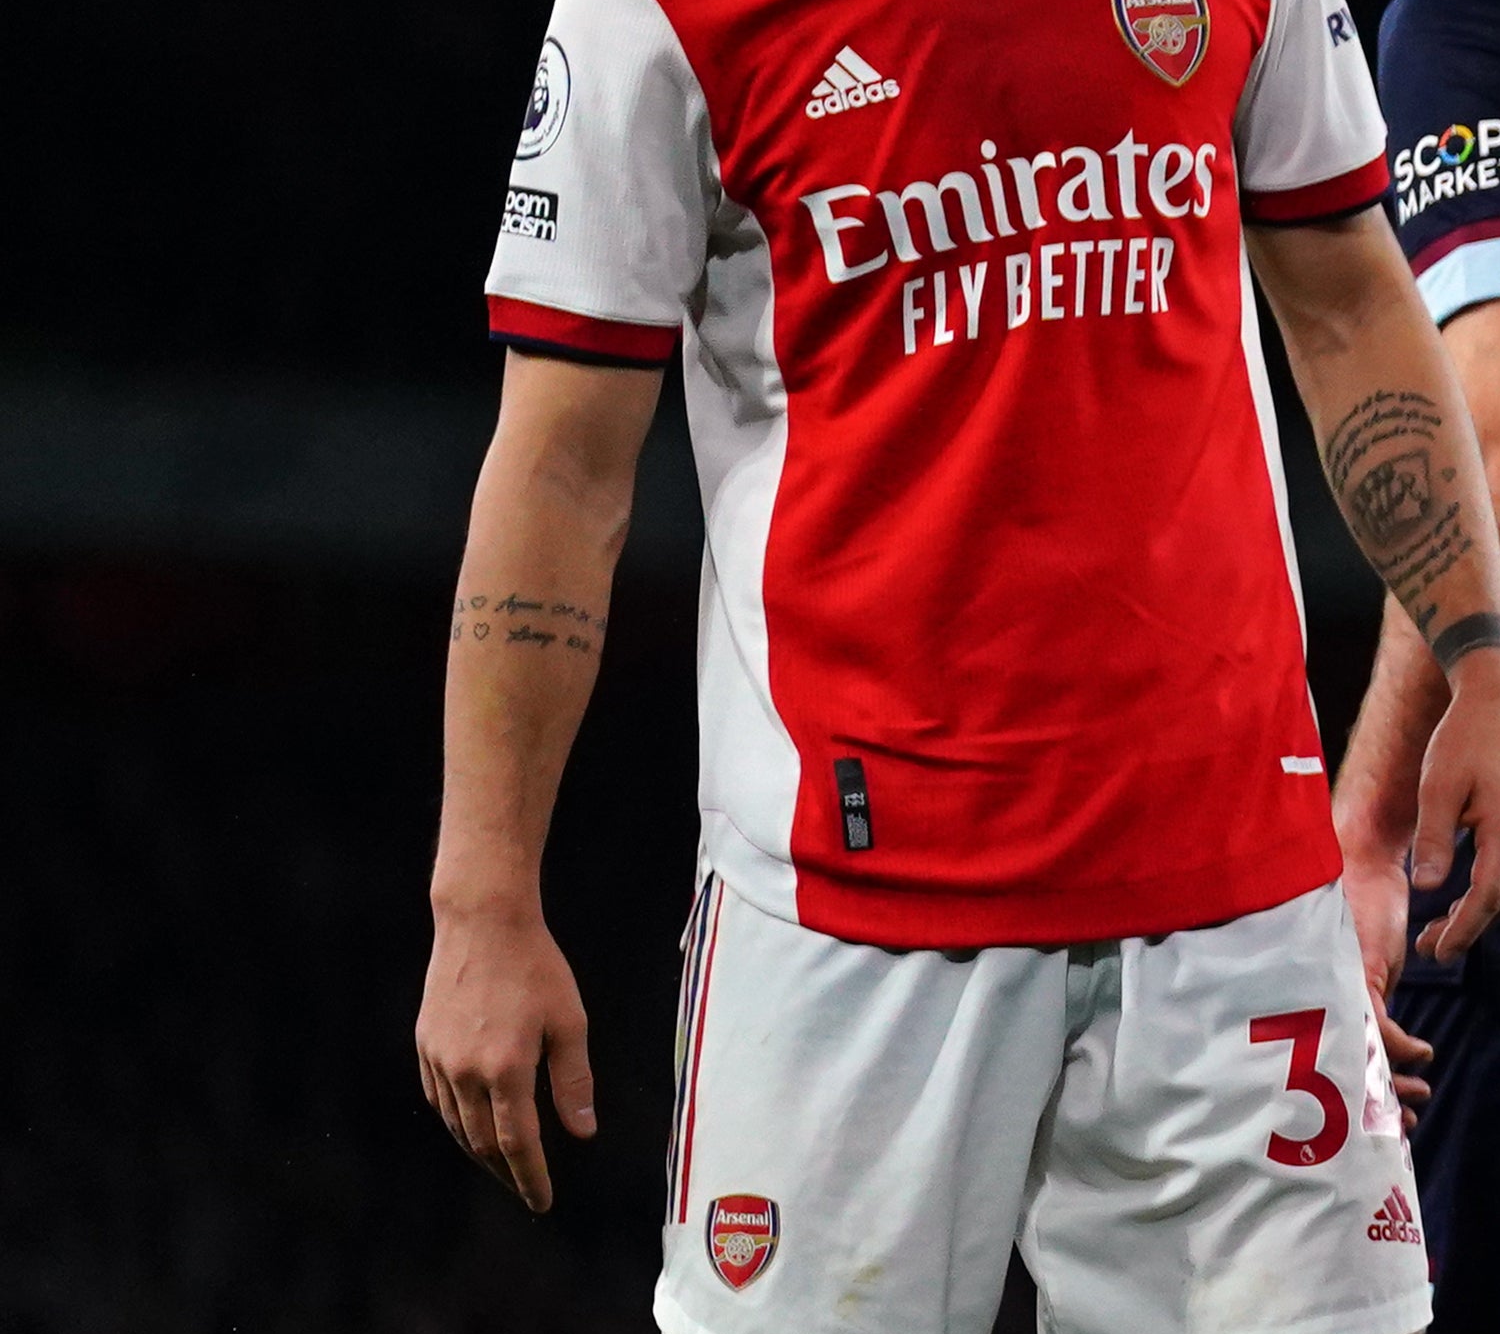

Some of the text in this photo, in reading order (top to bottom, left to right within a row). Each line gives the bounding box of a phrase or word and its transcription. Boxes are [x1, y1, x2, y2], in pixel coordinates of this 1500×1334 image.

[805, 78, 901, 120] adidas
[505, 190, 551, 218] oom
[800, 128, 1217, 284] Emirates
[902, 236, 1175, 356] FLY BETTER
[716, 1208, 769, 1226] Arsenal
